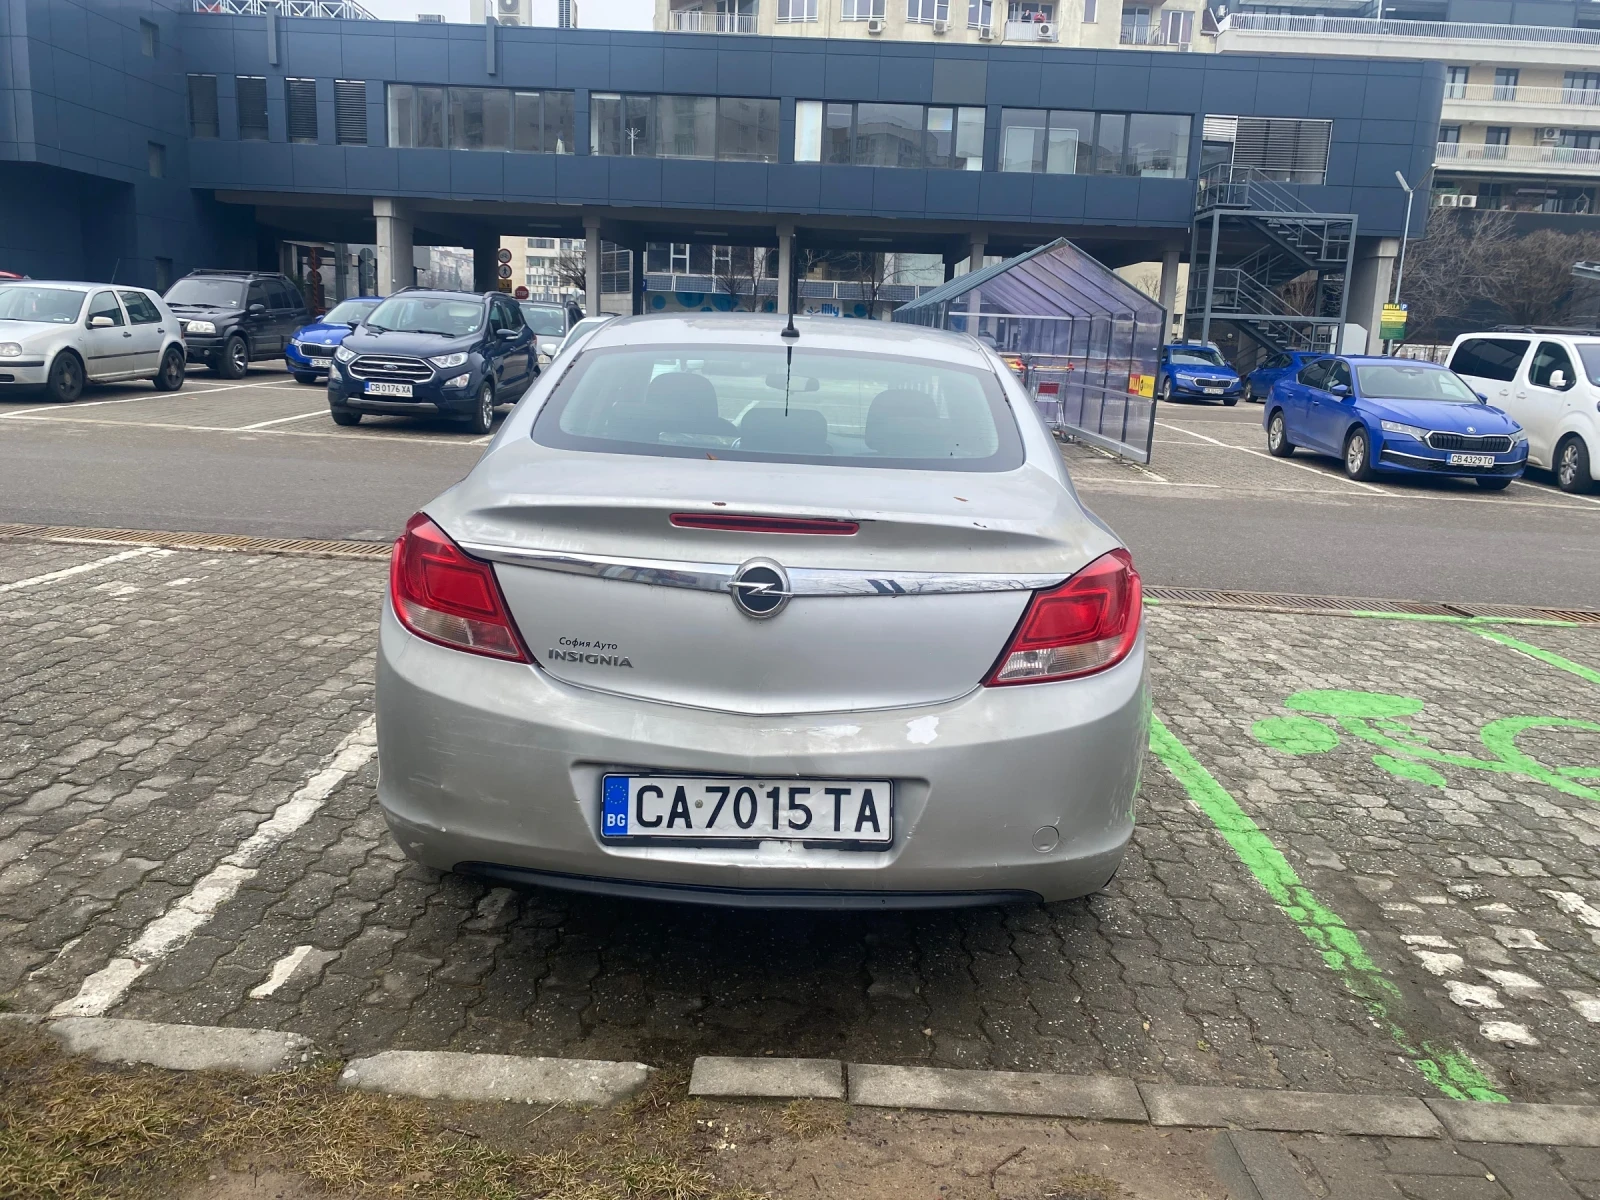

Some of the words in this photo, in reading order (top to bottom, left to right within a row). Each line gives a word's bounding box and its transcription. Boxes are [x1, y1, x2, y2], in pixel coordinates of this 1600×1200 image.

[821, 303, 840, 318] lilly
[1401, 303, 1408, 311] P
[370, 383, 381, 392] CB
[381, 384, 401, 393] 0176
[401, 385, 412, 394] XA
[1451, 454, 1463, 463] CB
[1463, 456, 1483, 465] 4329
[1483, 456, 1493, 465] TO
[559, 636, 591, 648] София
[593, 640, 618, 651] Ауто
[548, 647, 635, 669] INSIGNIA
[635, 784, 693, 829] CA
[704, 786, 813, 831] 7015
[824, 787, 881, 833] TA
[606, 813, 626, 827] BG
